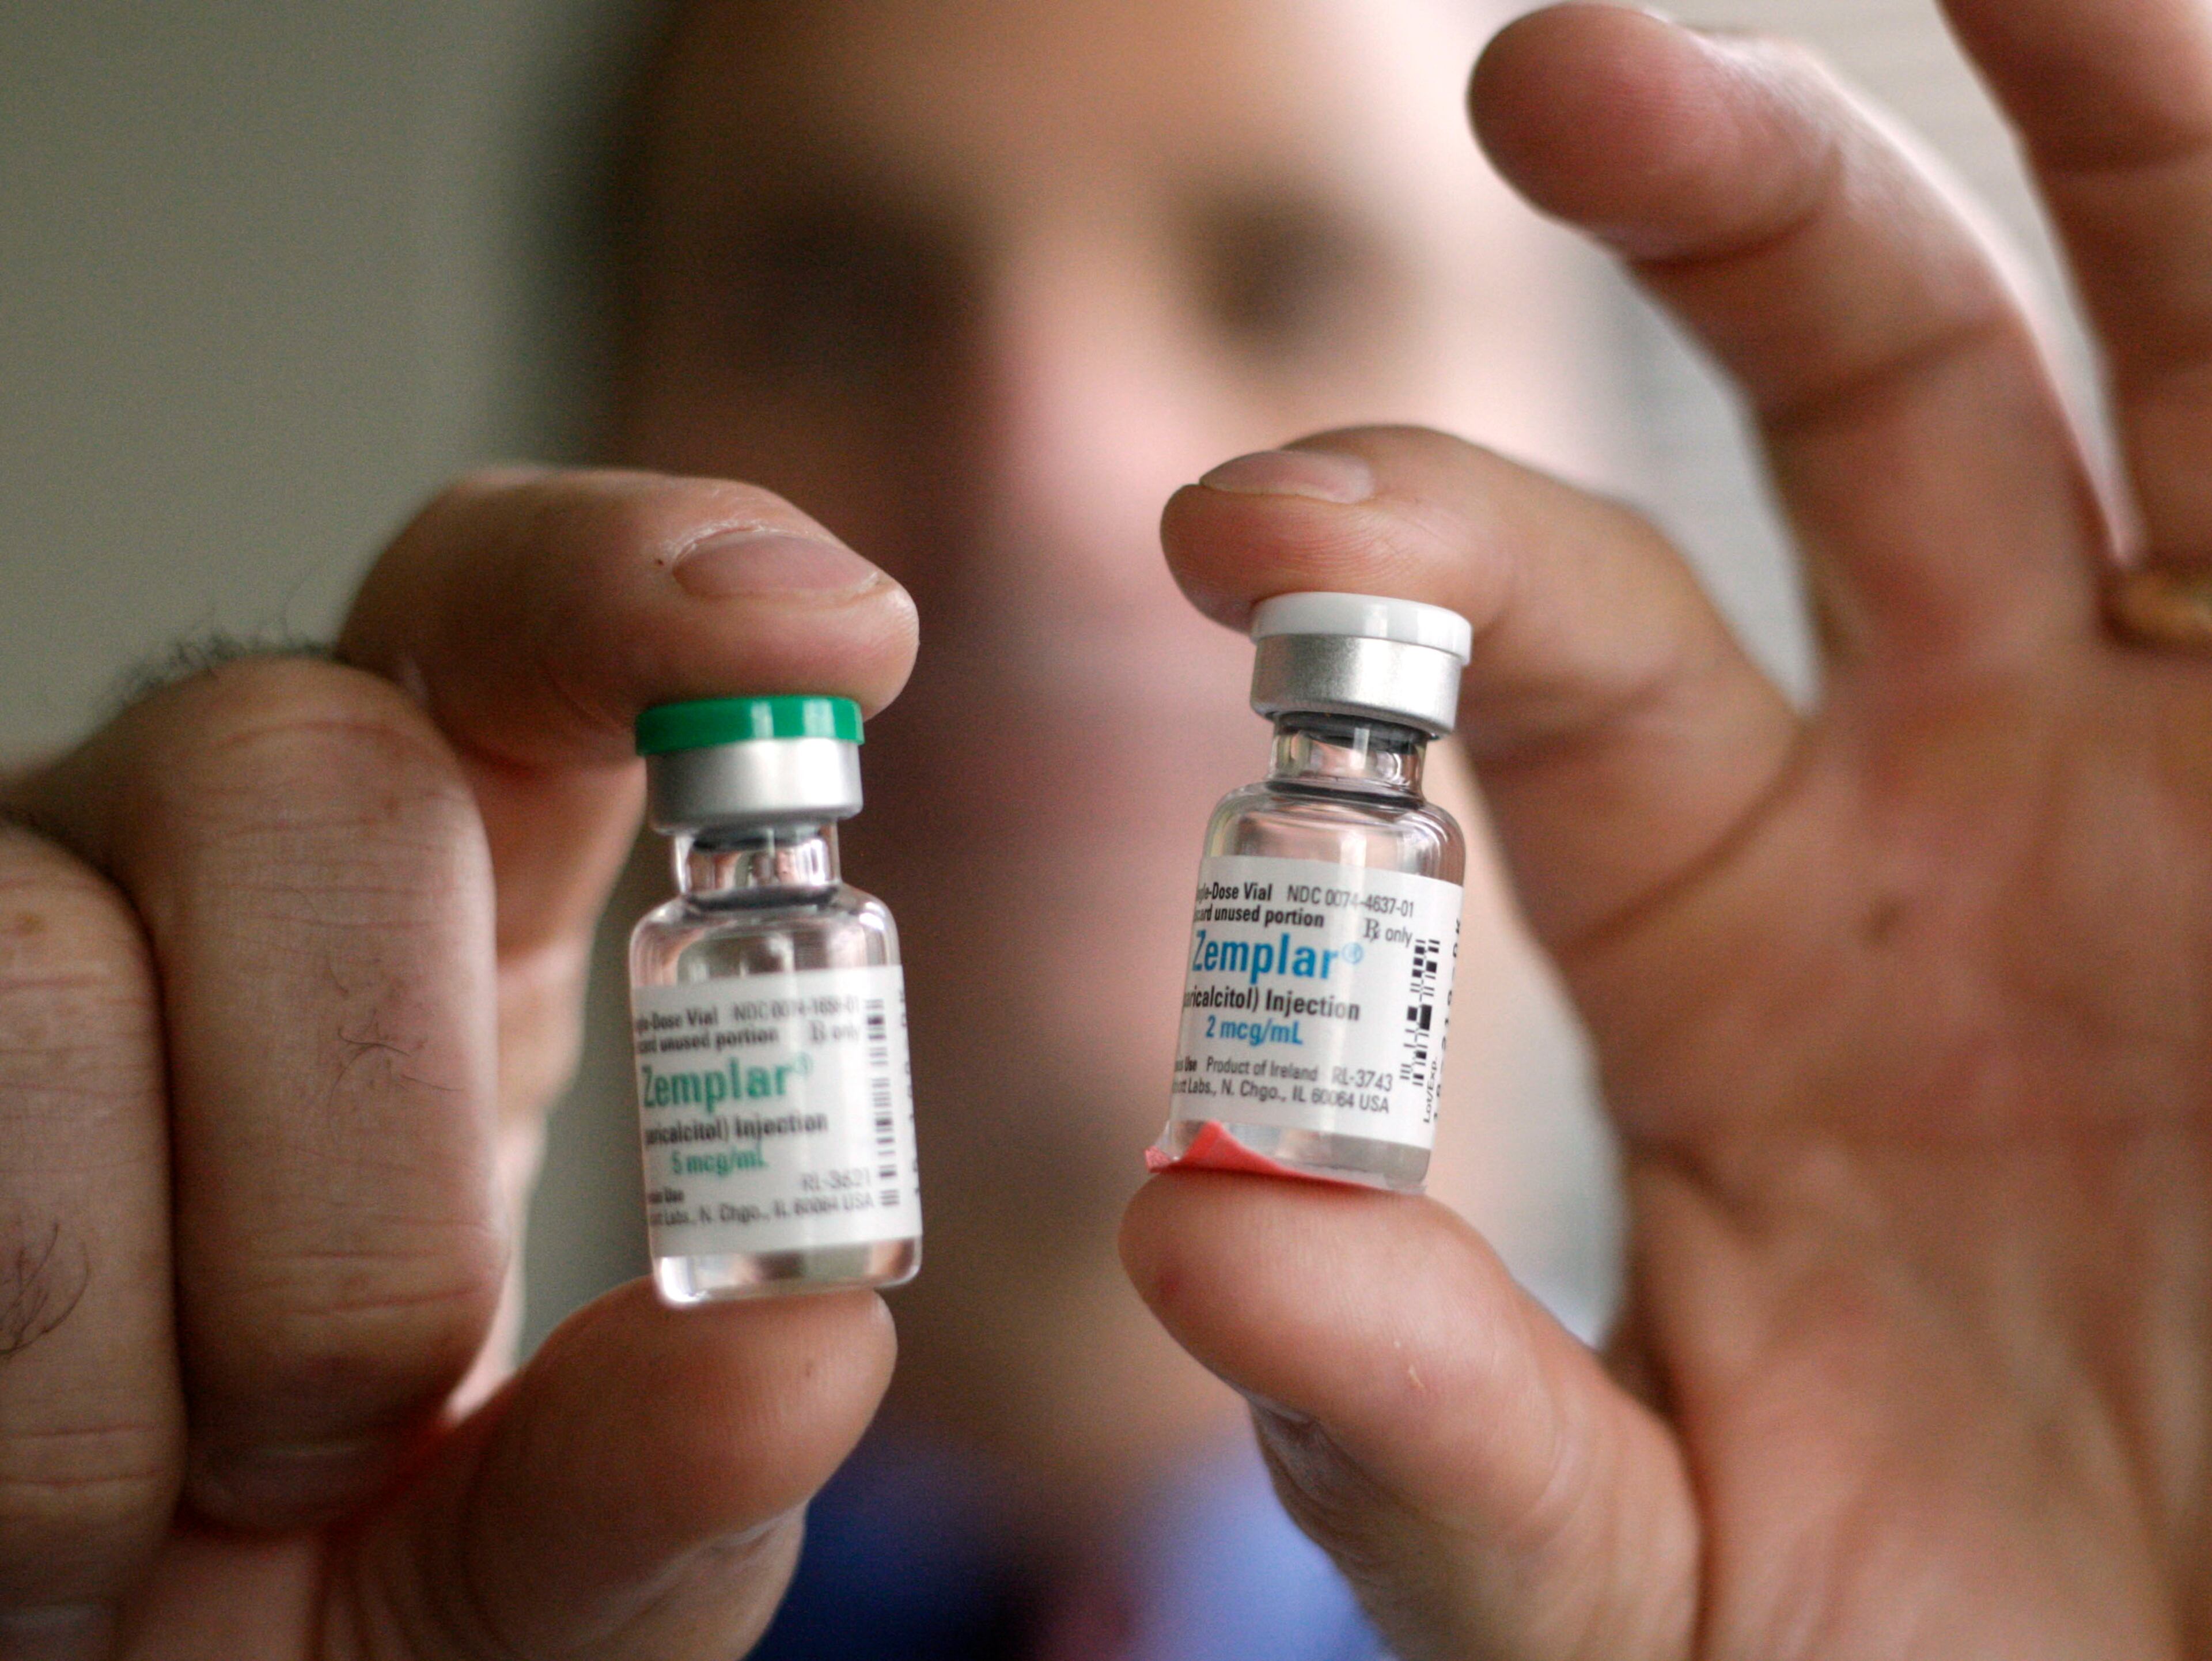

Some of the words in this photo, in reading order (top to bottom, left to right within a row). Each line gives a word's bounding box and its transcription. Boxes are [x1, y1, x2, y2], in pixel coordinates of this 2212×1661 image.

[1244, 882, 1272, 901] Vial
[1287, 884, 1321, 905] NDC
[1325, 888, 1414, 918] 0074-4637-01
[1215, 904, 1261, 922] unused
[1265, 907, 1325, 928] portion
[1385, 926, 1412, 948] only
[686, 1006, 719, 1026] Vial
[1266, 989, 1361, 1021] Injection
[660, 1030, 710, 1052] unused
[716, 1026, 779, 1053] portion
[1206, 1014, 1216, 1038] 2
[1219, 1018, 1302, 1046] mcg/mL
[1206, 1055, 1250, 1074] Product
[1253, 1059, 1268, 1076] of
[1270, 1061, 1319, 1082] Ireland
[1331, 1065, 1393, 1092] RL-3743
[1222, 1078, 1236, 1095] N.
[1292, 1085, 1306, 1103] IL
[1359, 1094, 1389, 1114] USA
[736, 1113, 828, 1142] Injection
[672, 1149, 683, 1175] 5
